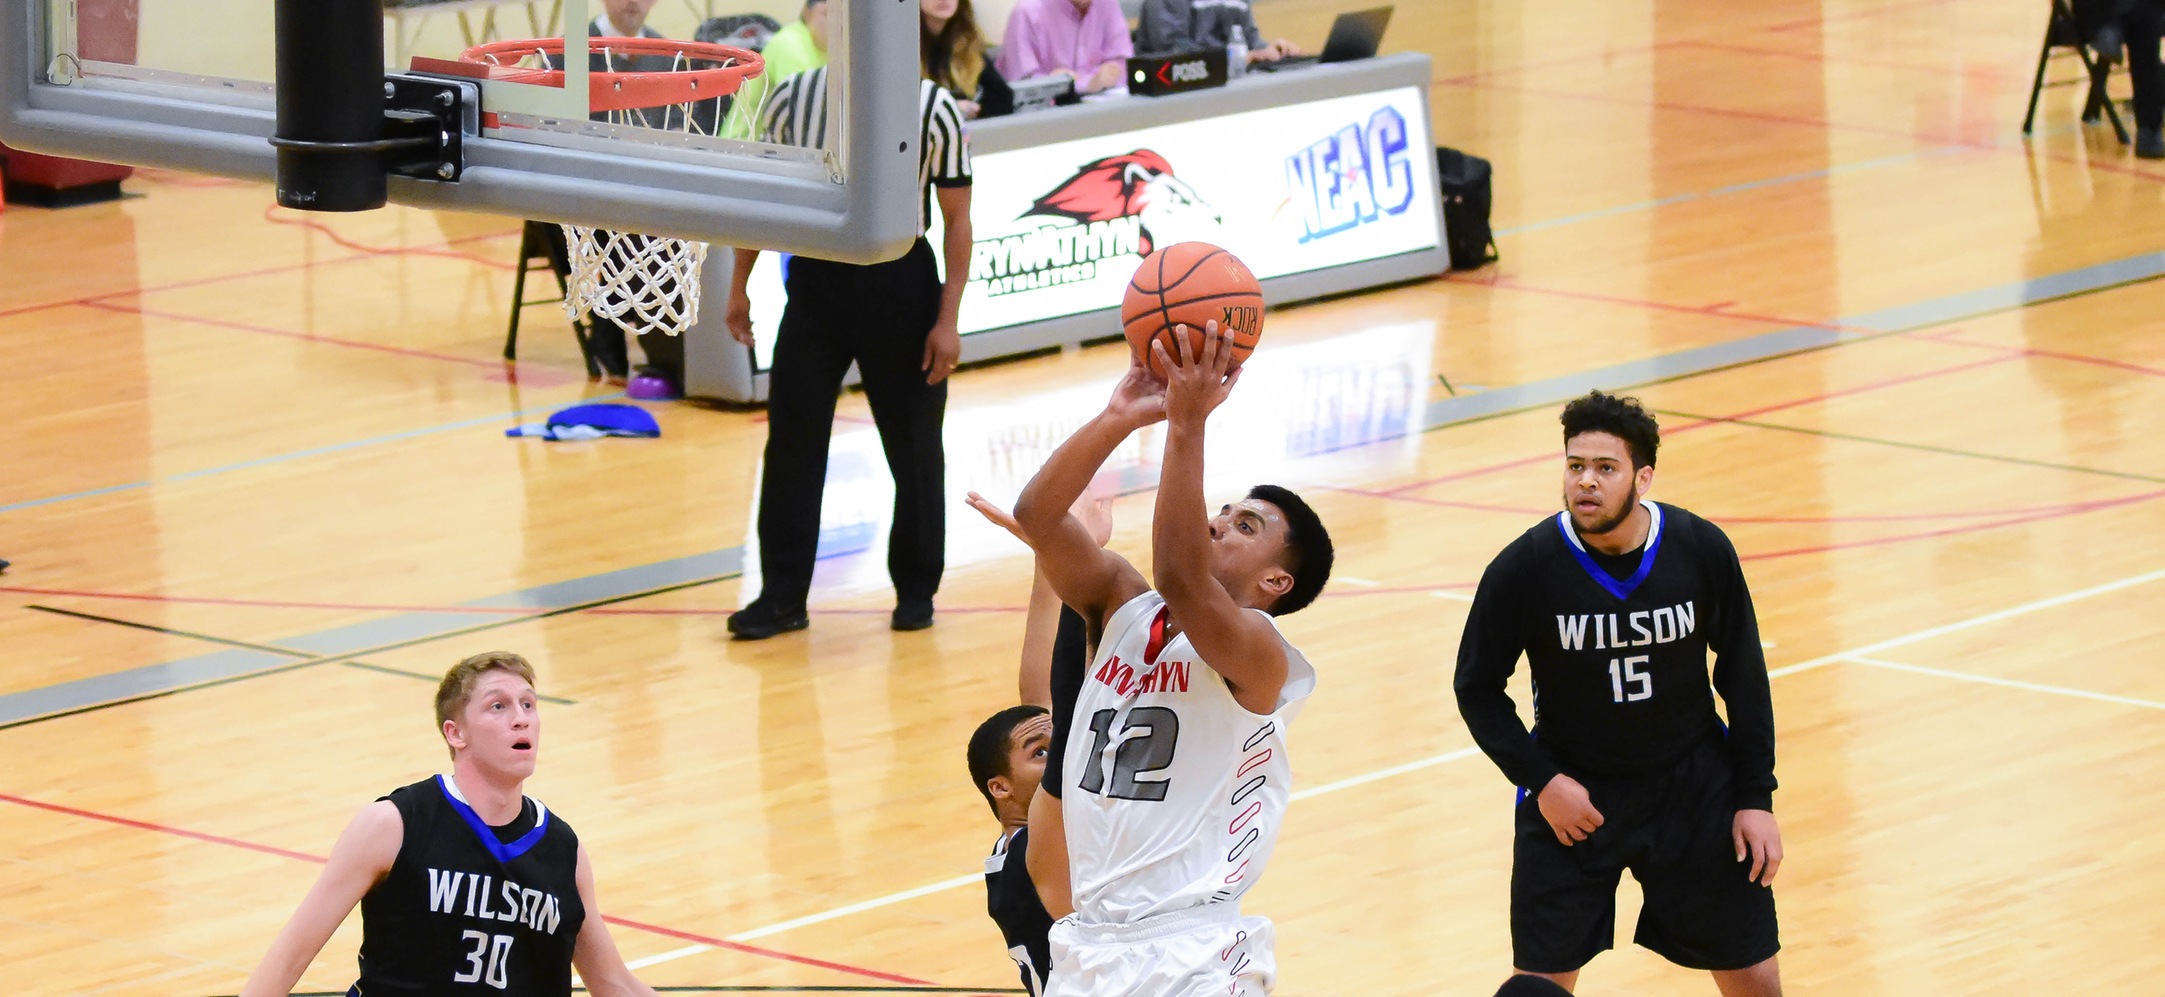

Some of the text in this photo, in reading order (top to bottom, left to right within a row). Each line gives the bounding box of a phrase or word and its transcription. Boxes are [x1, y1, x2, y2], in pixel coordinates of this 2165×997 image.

[1285, 104, 1414, 244] NEAC
[968, 213, 1141, 282] RYNATHYN
[988, 261, 1096, 297] ATHLETICS
[1222, 306, 1258, 336] ROCK
[1556, 601, 1696, 651] WILSON
[1609, 655, 1653, 703] 15
[1078, 706, 1180, 802] 12
[428, 868, 561, 935] WILSON
[454, 930, 515, 990] 30
